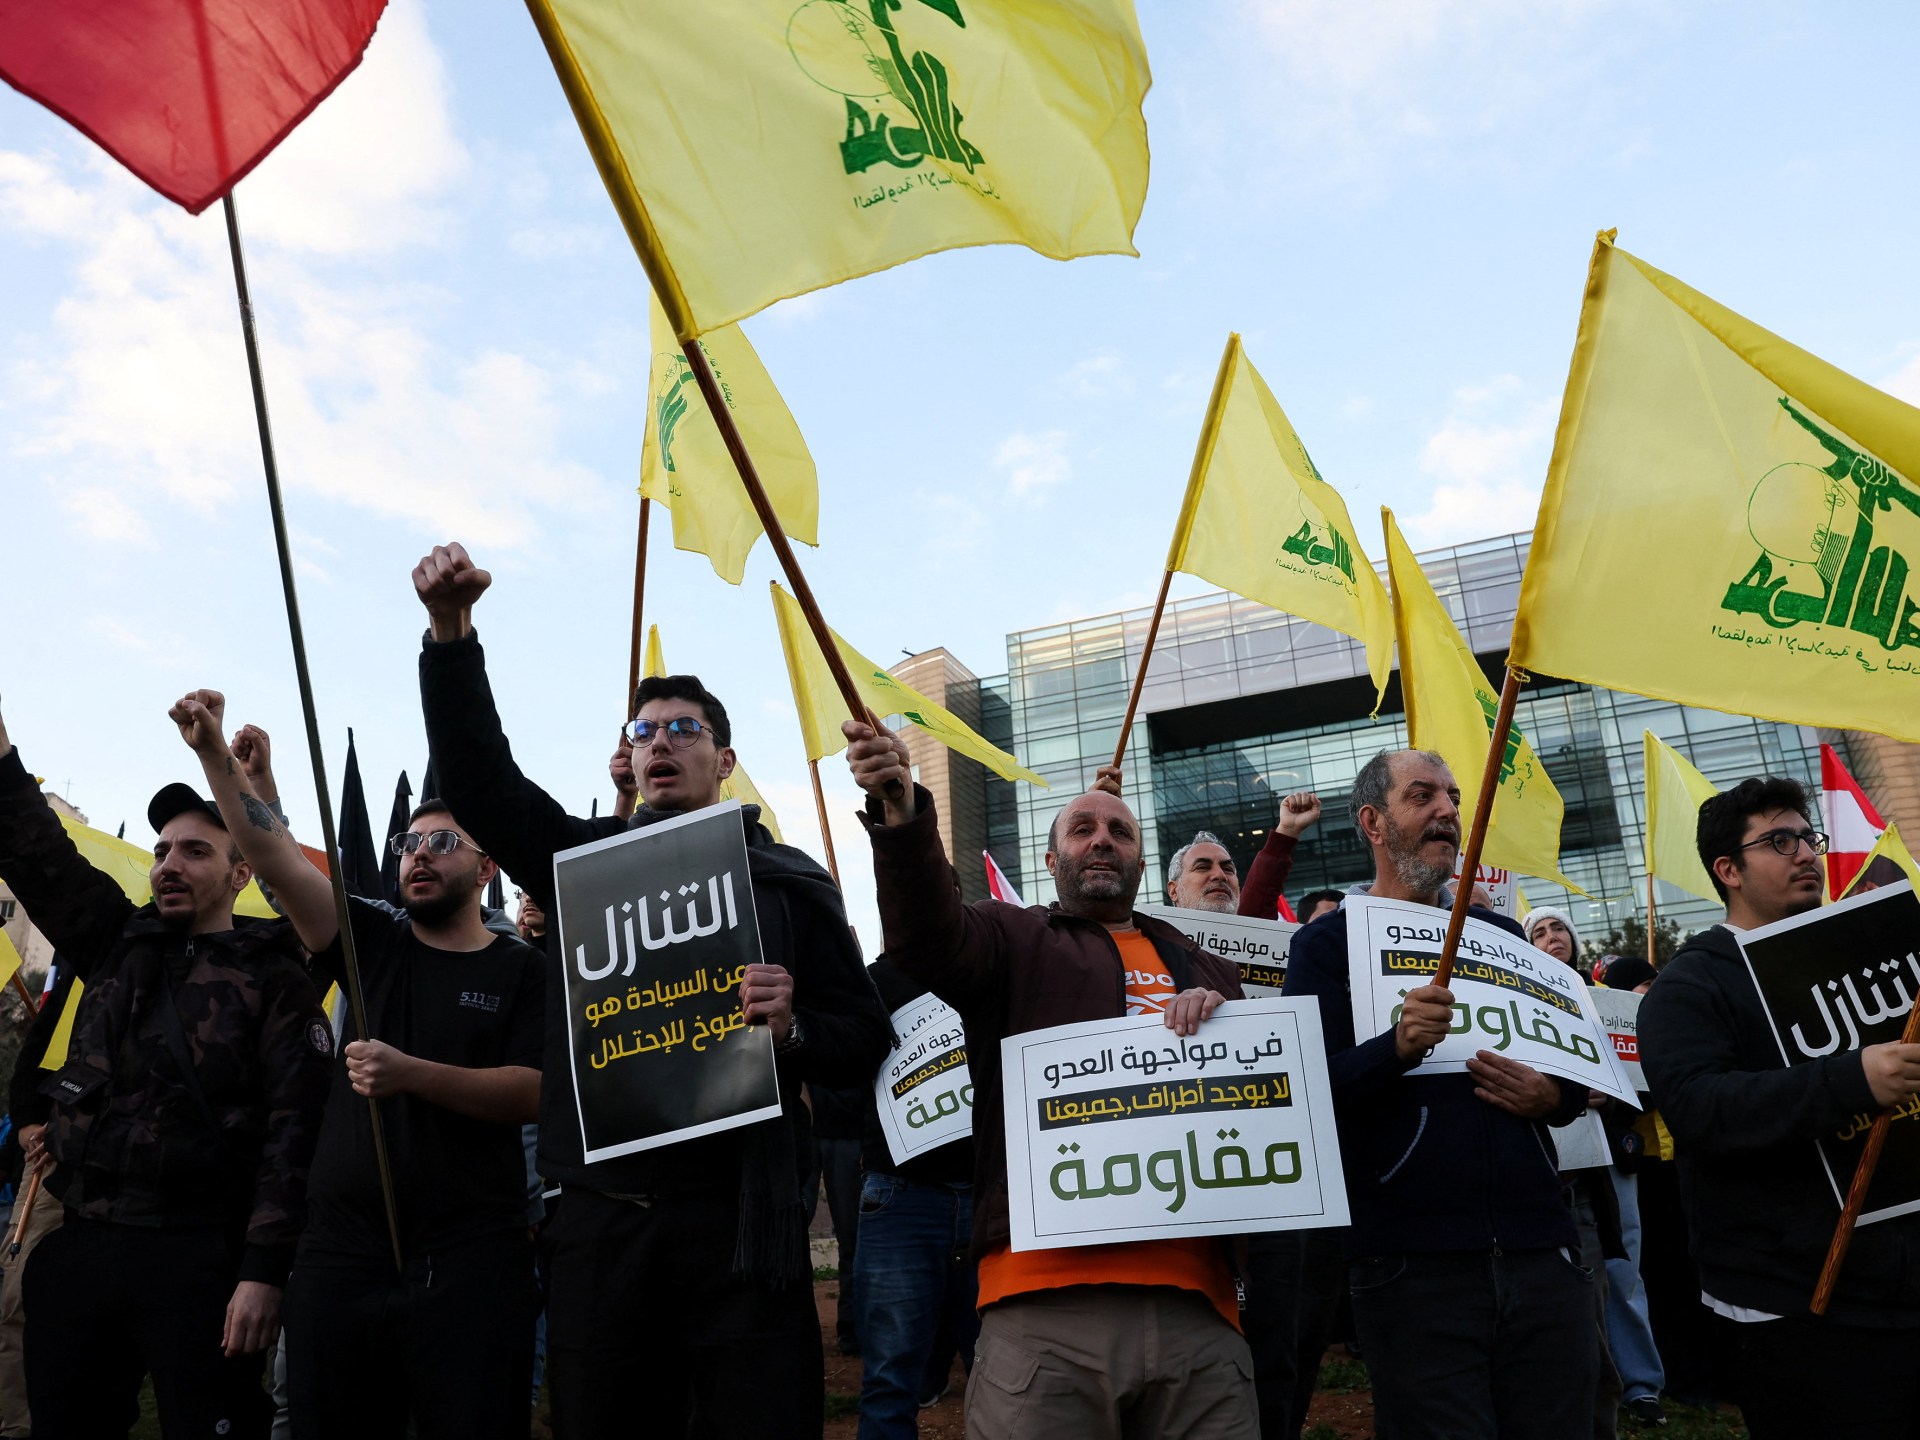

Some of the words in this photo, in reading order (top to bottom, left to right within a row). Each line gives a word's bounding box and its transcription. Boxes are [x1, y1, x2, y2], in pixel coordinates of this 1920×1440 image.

[575, 871, 739, 981] التنازل
[1386, 925, 1448, 945] العدو
[1207, 932, 1270, 960] مواجهة
[625, 968, 709, 1010] السيادة
[1525, 980, 1569, 1014] يوجد
[1538, 969, 1571, 991] في
[459, 991, 486, 1005] 5.11
[584, 995, 622, 1028] هو
[1570, 1000, 1581, 1015] لا
[590, 1018, 687, 1069] للإحتلال
[891, 1042, 928, 1079] العدو
[1120, 1038, 1228, 1076] مواجهة
[1235, 1031, 1284, 1071] في
[1043, 1048, 1114, 1090] العدو
[1209, 1085, 1270, 1109] يوجد
[1273, 1075, 1290, 1100] لا
[1048, 1126, 1303, 1214] مقاومة
